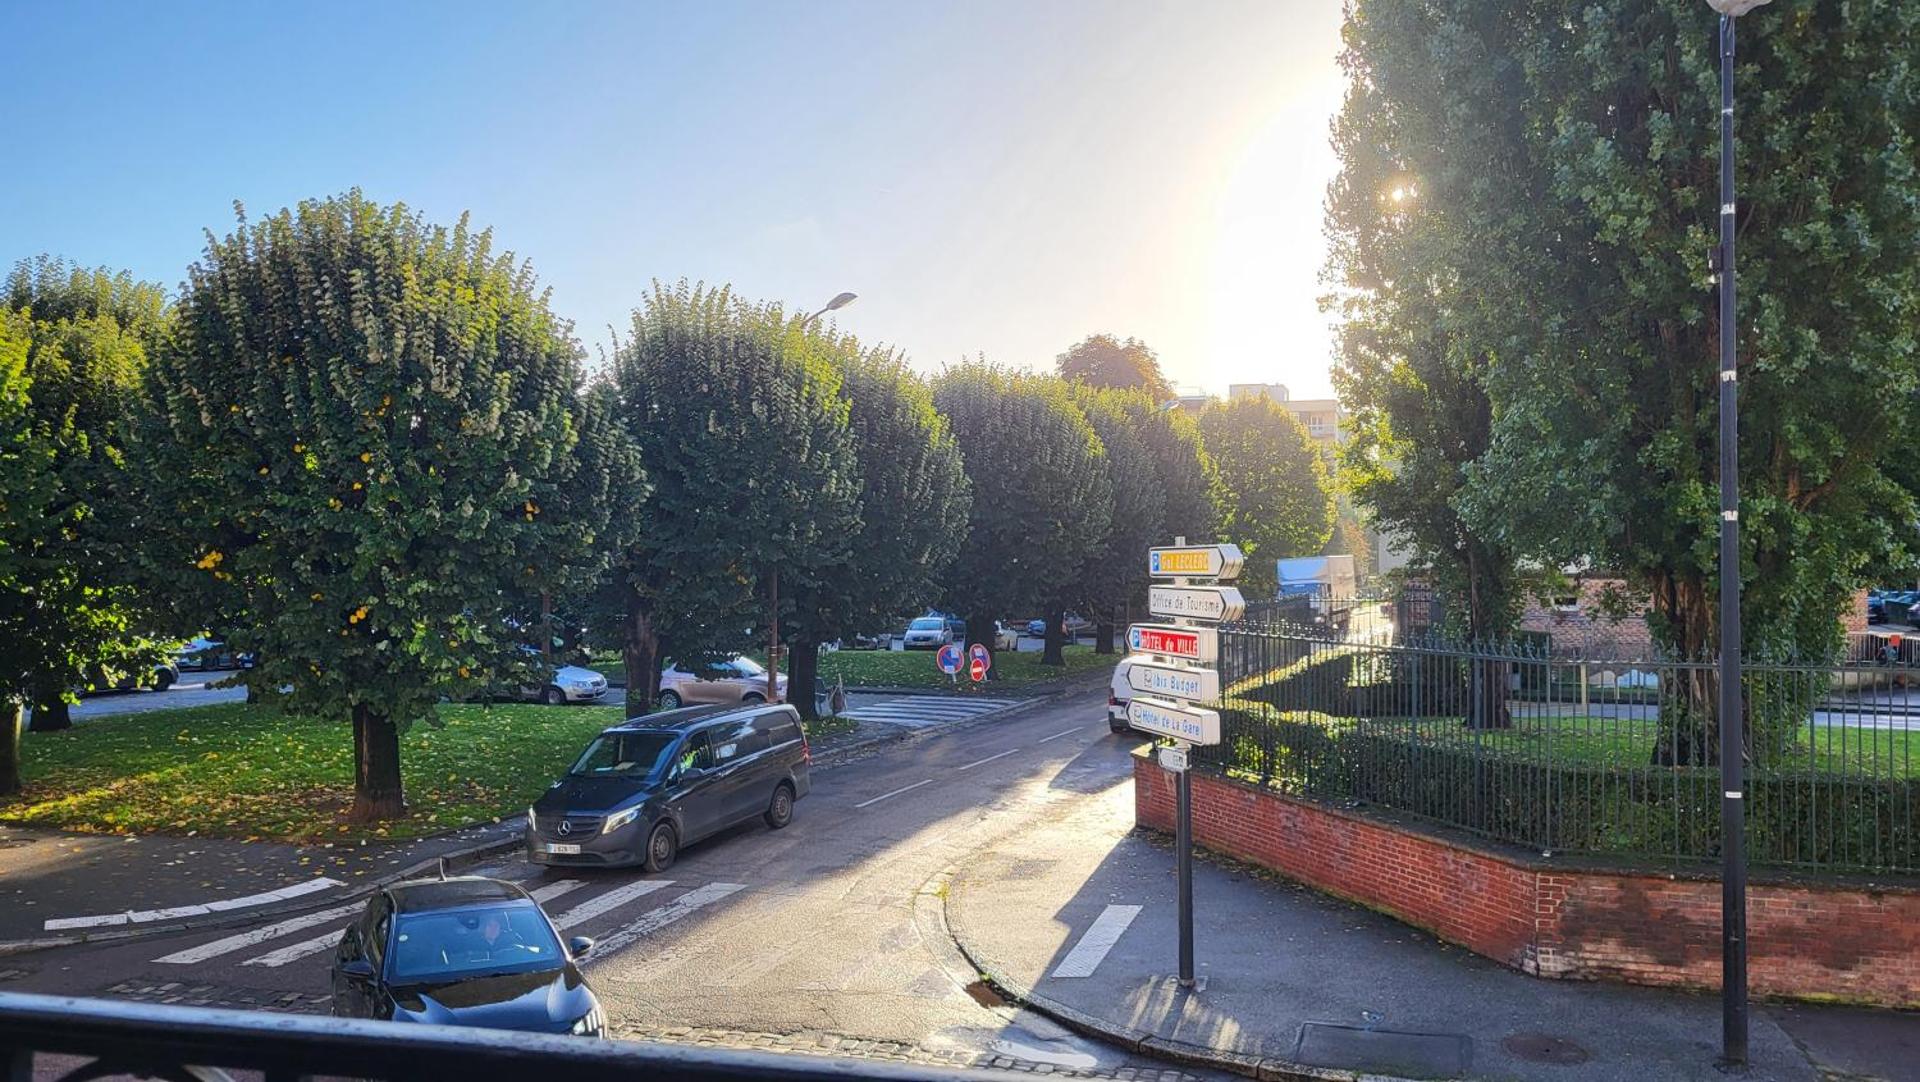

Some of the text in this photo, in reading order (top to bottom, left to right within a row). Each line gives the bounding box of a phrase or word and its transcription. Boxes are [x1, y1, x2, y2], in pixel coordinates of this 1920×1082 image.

[1152, 593, 1220, 612] Office de Tourisme
[1165, 640, 1175, 652] de
[1177, 638, 1198, 655] VILLE
[1170, 676, 1199, 695] Budget
[1161, 714, 1170, 728] de
[1182, 719, 1200, 736] Gare
